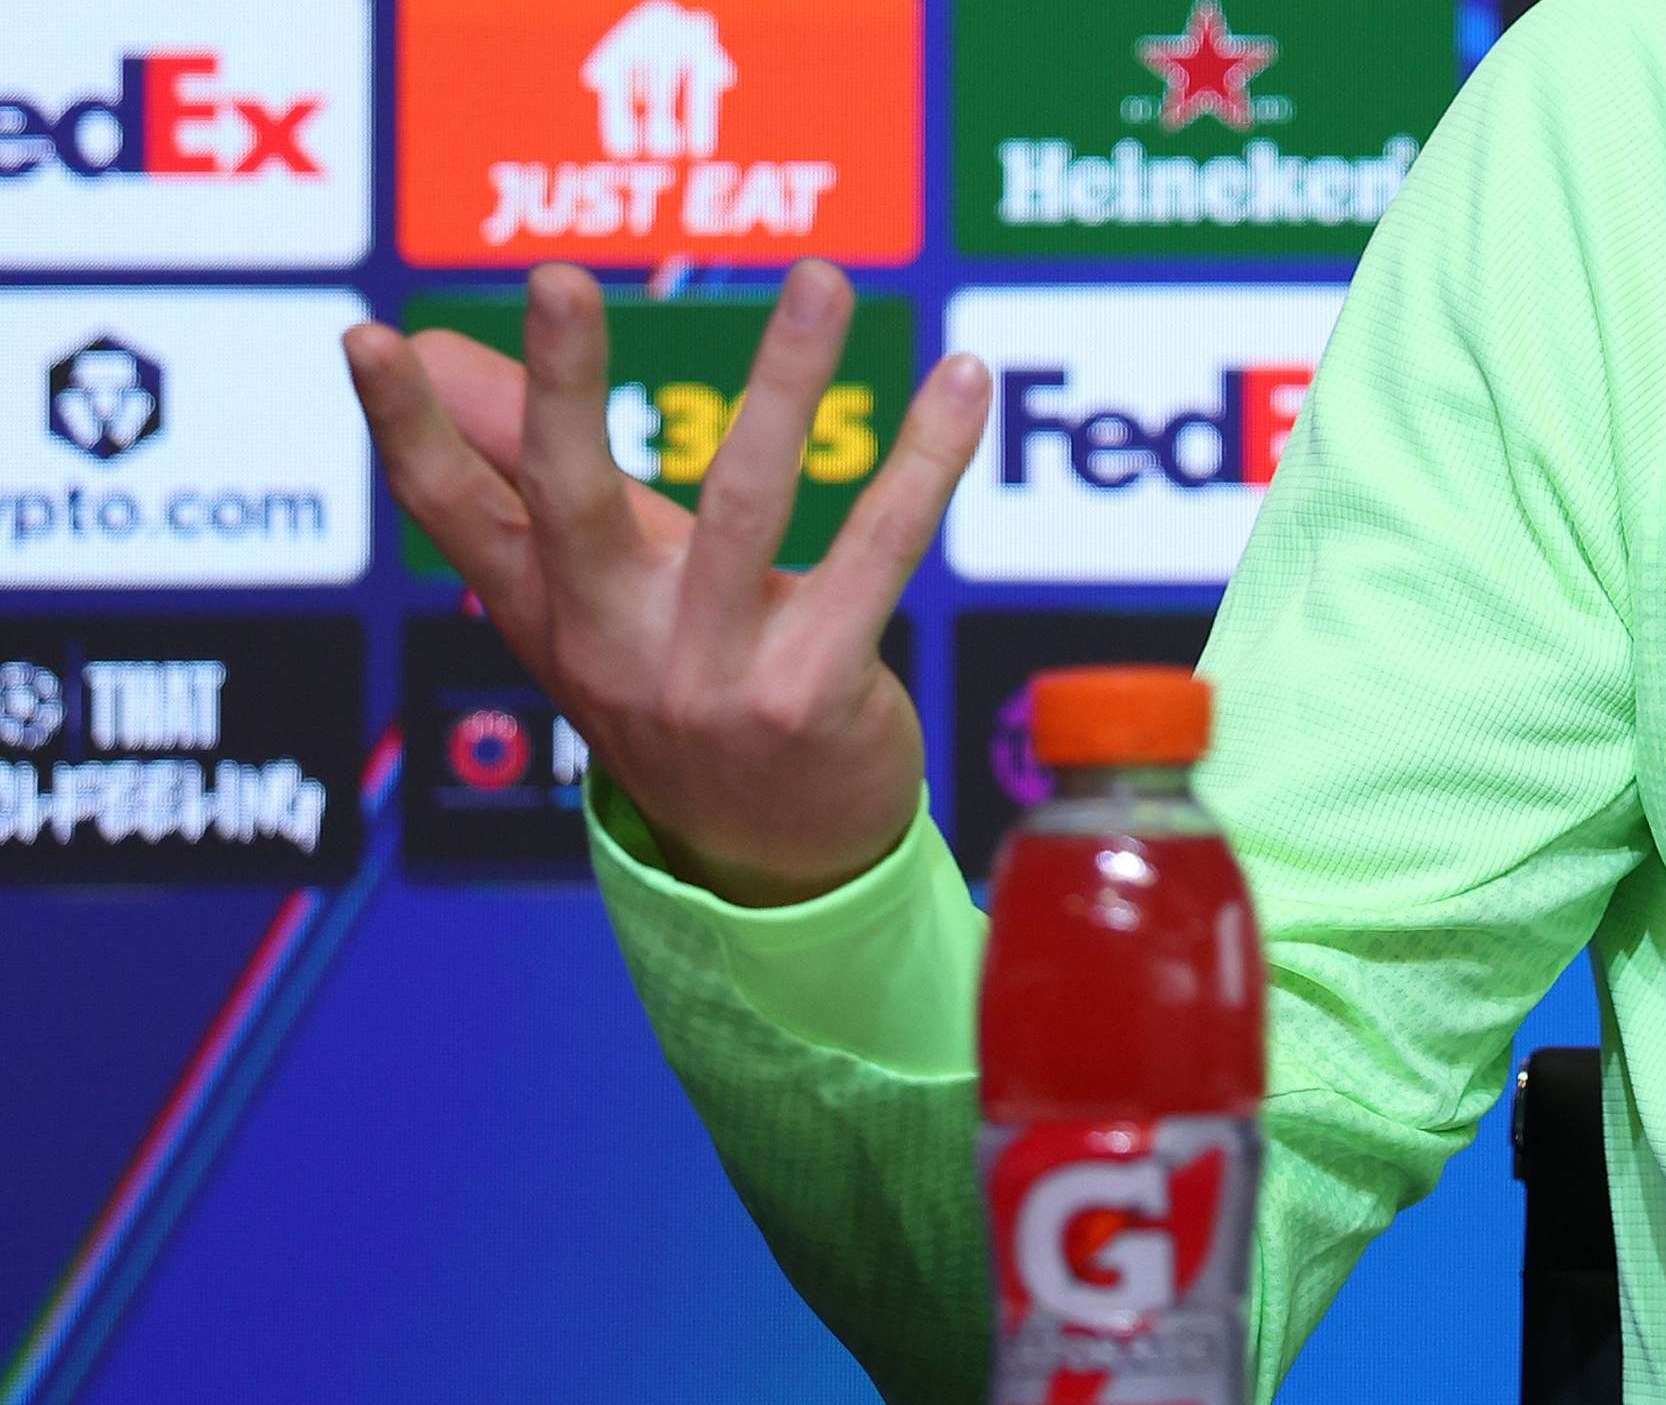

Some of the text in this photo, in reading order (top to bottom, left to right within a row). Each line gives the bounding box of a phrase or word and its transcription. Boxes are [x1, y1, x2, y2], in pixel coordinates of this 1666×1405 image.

[481, 161, 838, 247] JUST EAT
[996, 136, 1416, 227] Heineken
[1000, 367, 1314, 488] FedE
[1014, 1157, 1177, 1331] G
